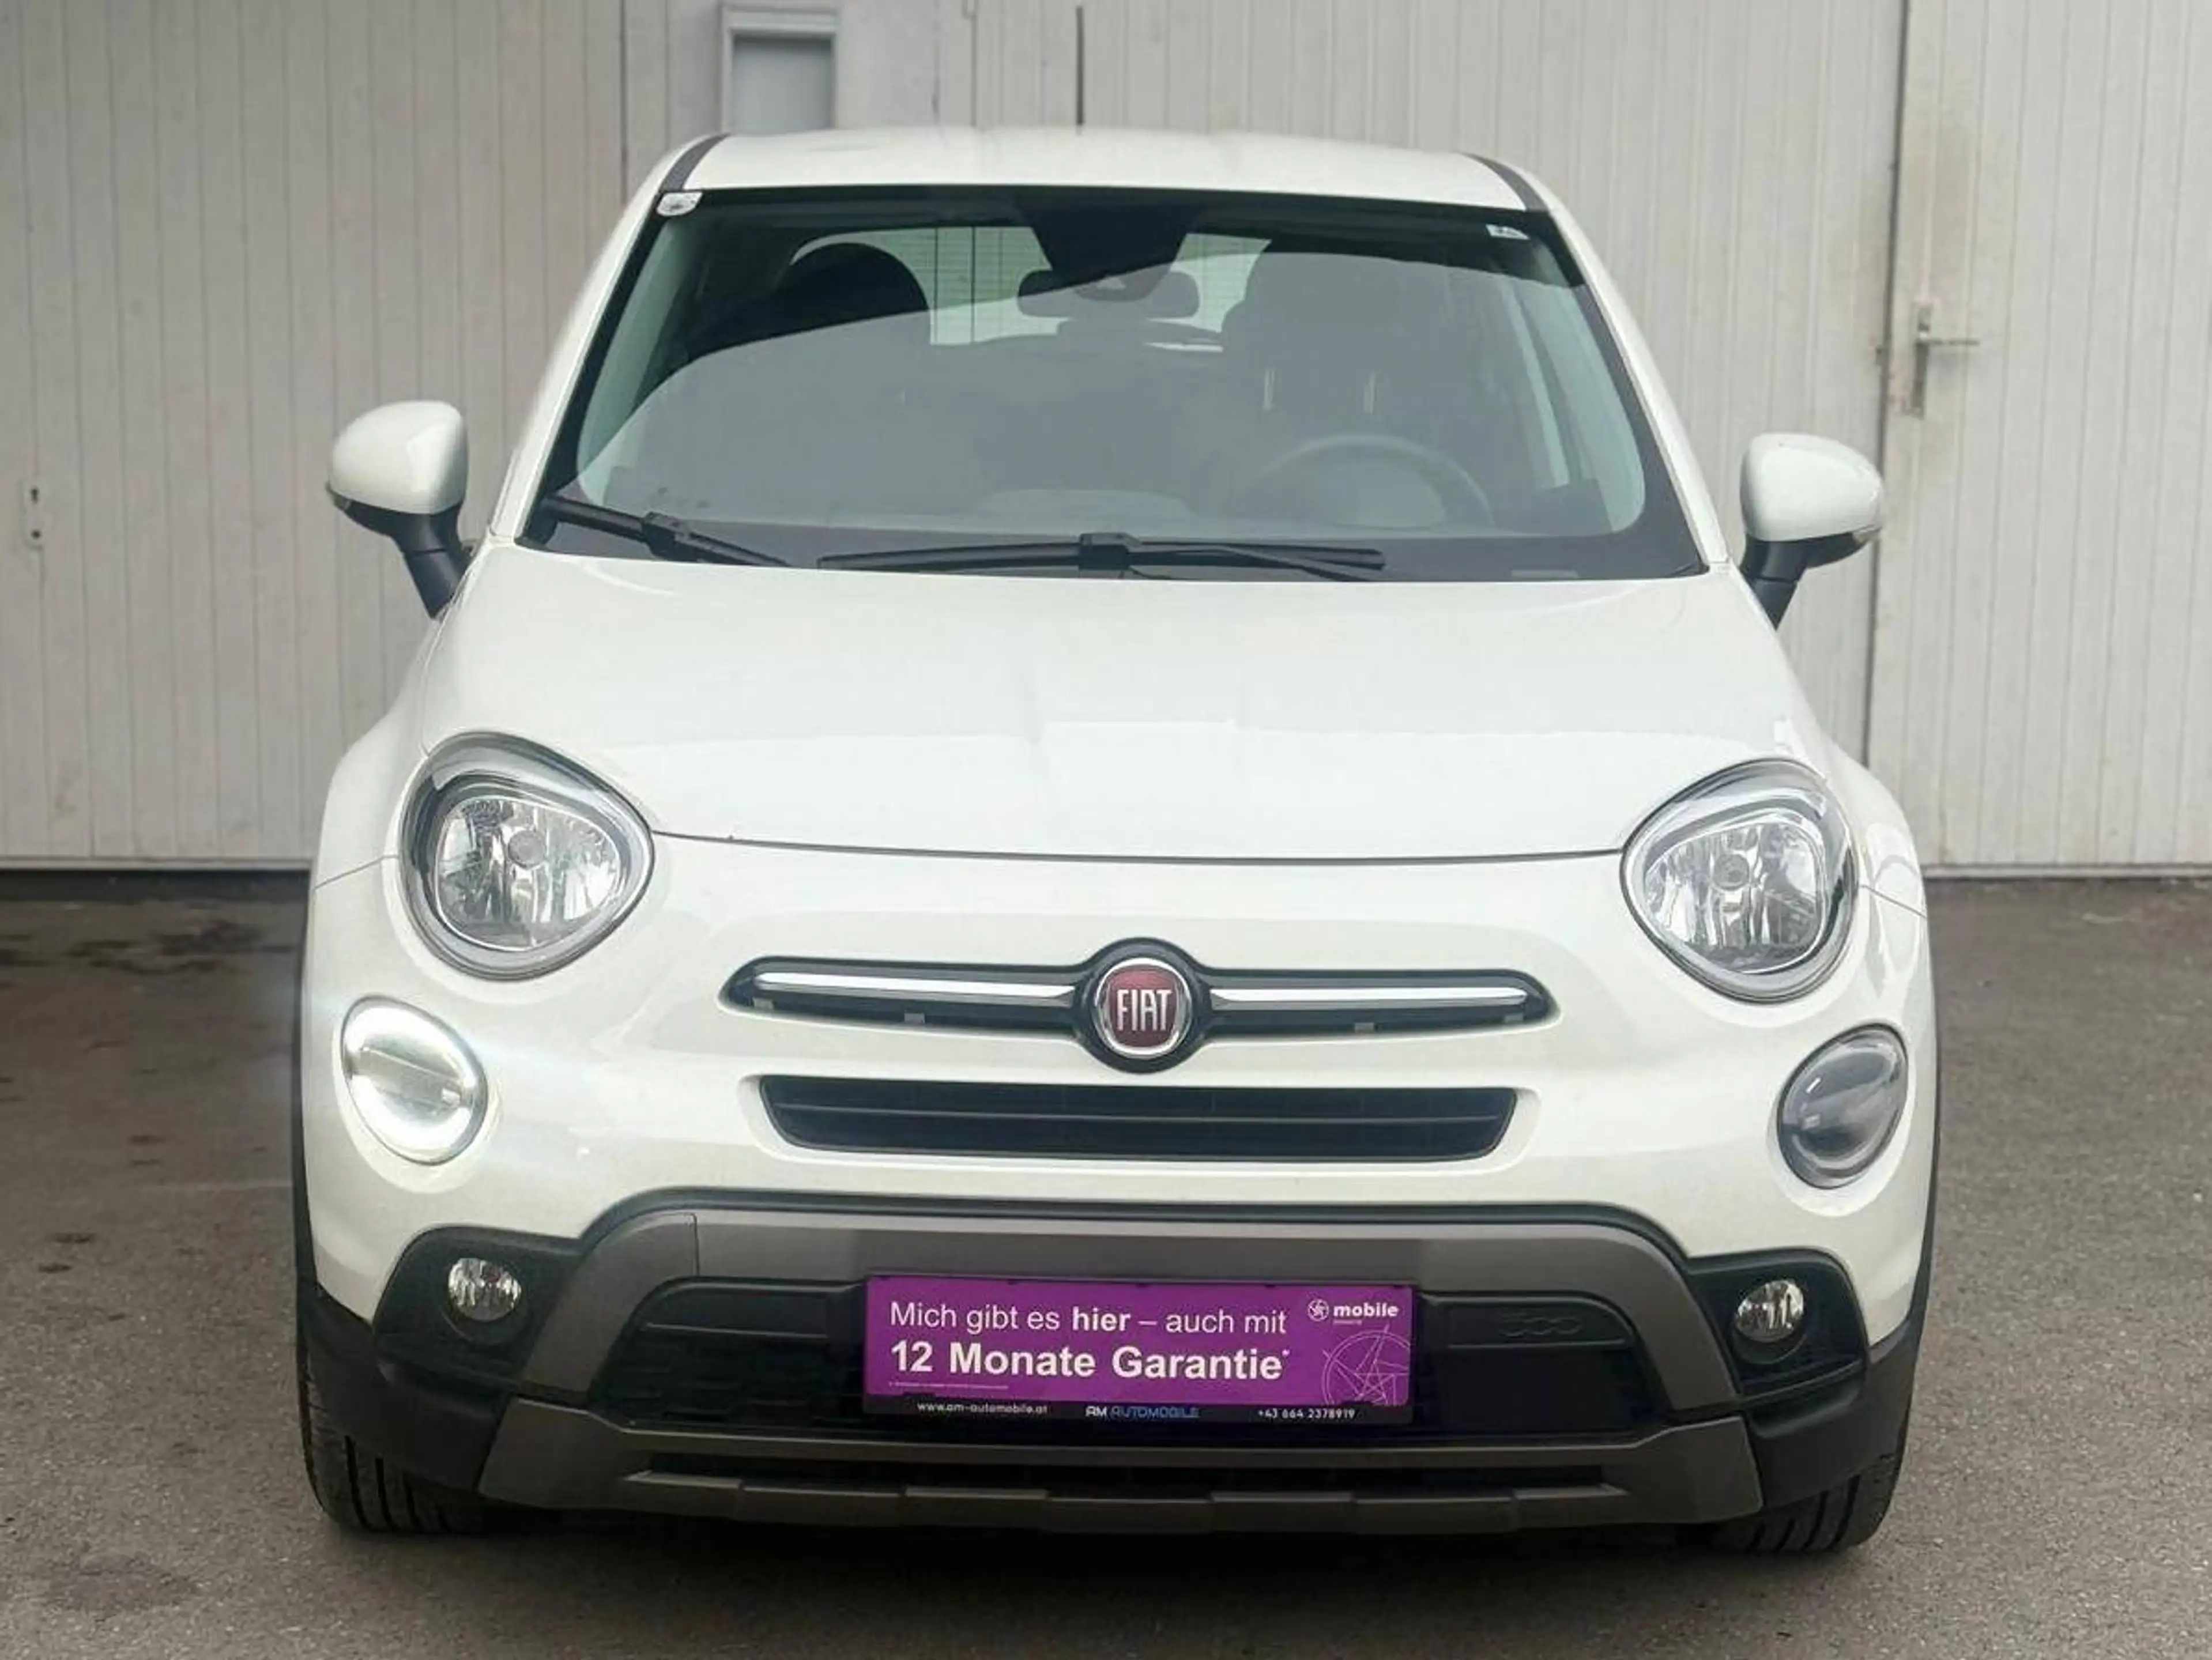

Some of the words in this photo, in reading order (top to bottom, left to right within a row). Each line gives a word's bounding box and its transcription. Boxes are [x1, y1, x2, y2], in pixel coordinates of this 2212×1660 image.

[1116, 989, 1173, 1032] FIAT
[890, 1301, 957, 1327] Mich
[966, 1304, 1018, 1335] gibt
[1026, 1310, 1060, 1330] es
[1072, 1306, 1131, 1331] hier
[1166, 1309, 1233, 1334] auch
[1244, 1310, 1287, 1334] mit
[1333, 1302, 1400, 1317] mobile
[890, 1340, 934, 1372] 12
[949, 1342, 1096, 1377] Monate
[1085, 1405, 1107, 1417] AM
